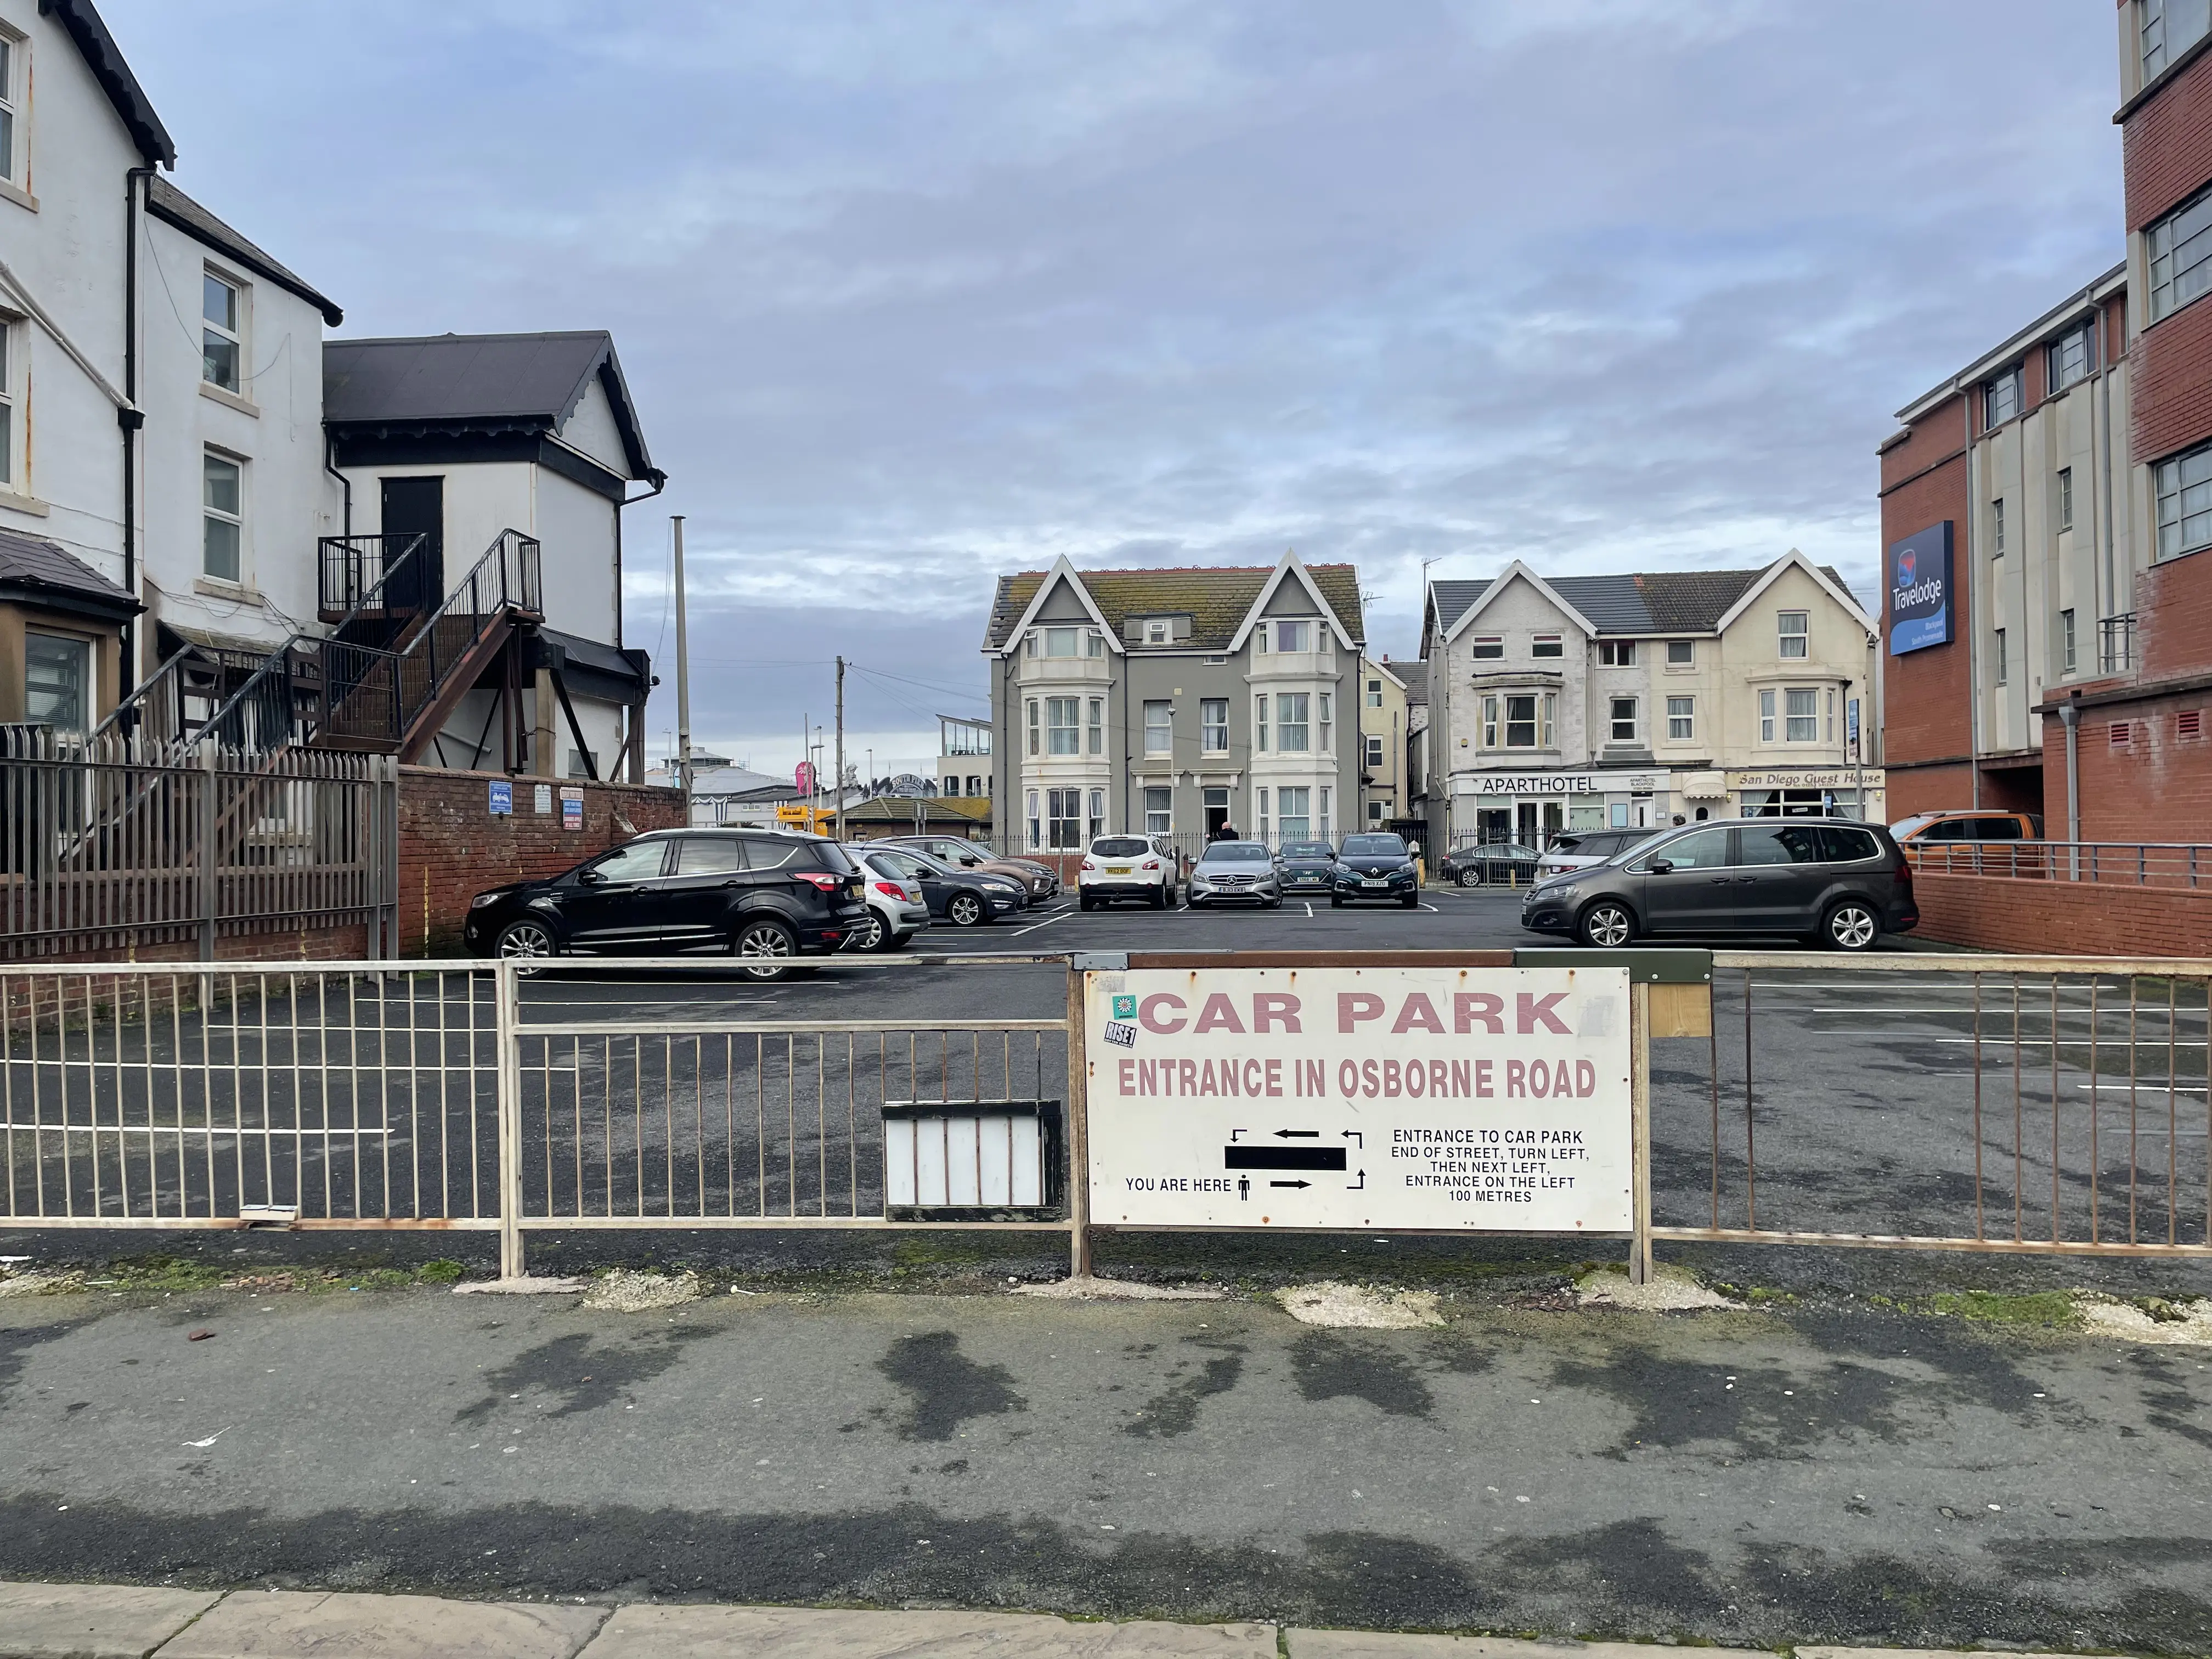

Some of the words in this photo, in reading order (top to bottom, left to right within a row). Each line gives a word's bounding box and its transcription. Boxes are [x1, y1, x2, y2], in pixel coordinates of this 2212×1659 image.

[1893, 577, 1942, 611] Travelodge
[1925, 617, 1943, 630] Blackpool
[1911, 636, 1922, 645] South
[891, 775, 910, 787] SOUTH
[911, 775, 924, 789] PIER
[1483, 777, 1598, 792] APARTHOTEL
[1739, 775, 1762, 785] San
[1767, 774, 1800, 786] Diego
[1804, 774, 1839, 784] Guest
[1844, 773, 1881, 783] House
[1138, 992, 1302, 1034] CAR
[1339, 992, 1573, 1034] PARK
[1105, 1023, 1136, 1044] RISE1
[1119, 1059, 1282, 1097] ENTRANCE
[1296, 1060, 1325, 1097] IN
[1339, 1059, 1494, 1098] OSBORNE
[1508, 1059, 1595, 1098] ROAD
[1393, 1129, 1474, 1142] ENTRANCE
[1479, 1130, 1499, 1143] TO
[1505, 1130, 1536, 1143] CAR
[1542, 1131, 1583, 1143] PARK
[1391, 1147, 1419, 1158] END
[1424, 1147, 1441, 1158] OF
[1447, 1147, 1503, 1160] STREET,
[1508, 1148, 1546, 1159] TURN
[1551, 1149, 1589, 1161] LEFT,
[1430, 1161, 1466, 1172] THEN
[1472, 1162, 1508, 1173] NEXT
[1513, 1163, 1550, 1175] LEFT,
[1125, 1178, 1154, 1191] YOU
[1160, 1178, 1188, 1191] ARE
[1193, 1178, 1231, 1192] HERE
[1406, 1175, 1480, 1187] ENTRANCE
[1485, 1176, 1504, 1187] ON
[1509, 1177, 1536, 1188] THE
[1542, 1177, 1575, 1188] LEFT
[1449, 1190, 1470, 1201] 100
[1476, 1191, 1531, 1203] METRES
